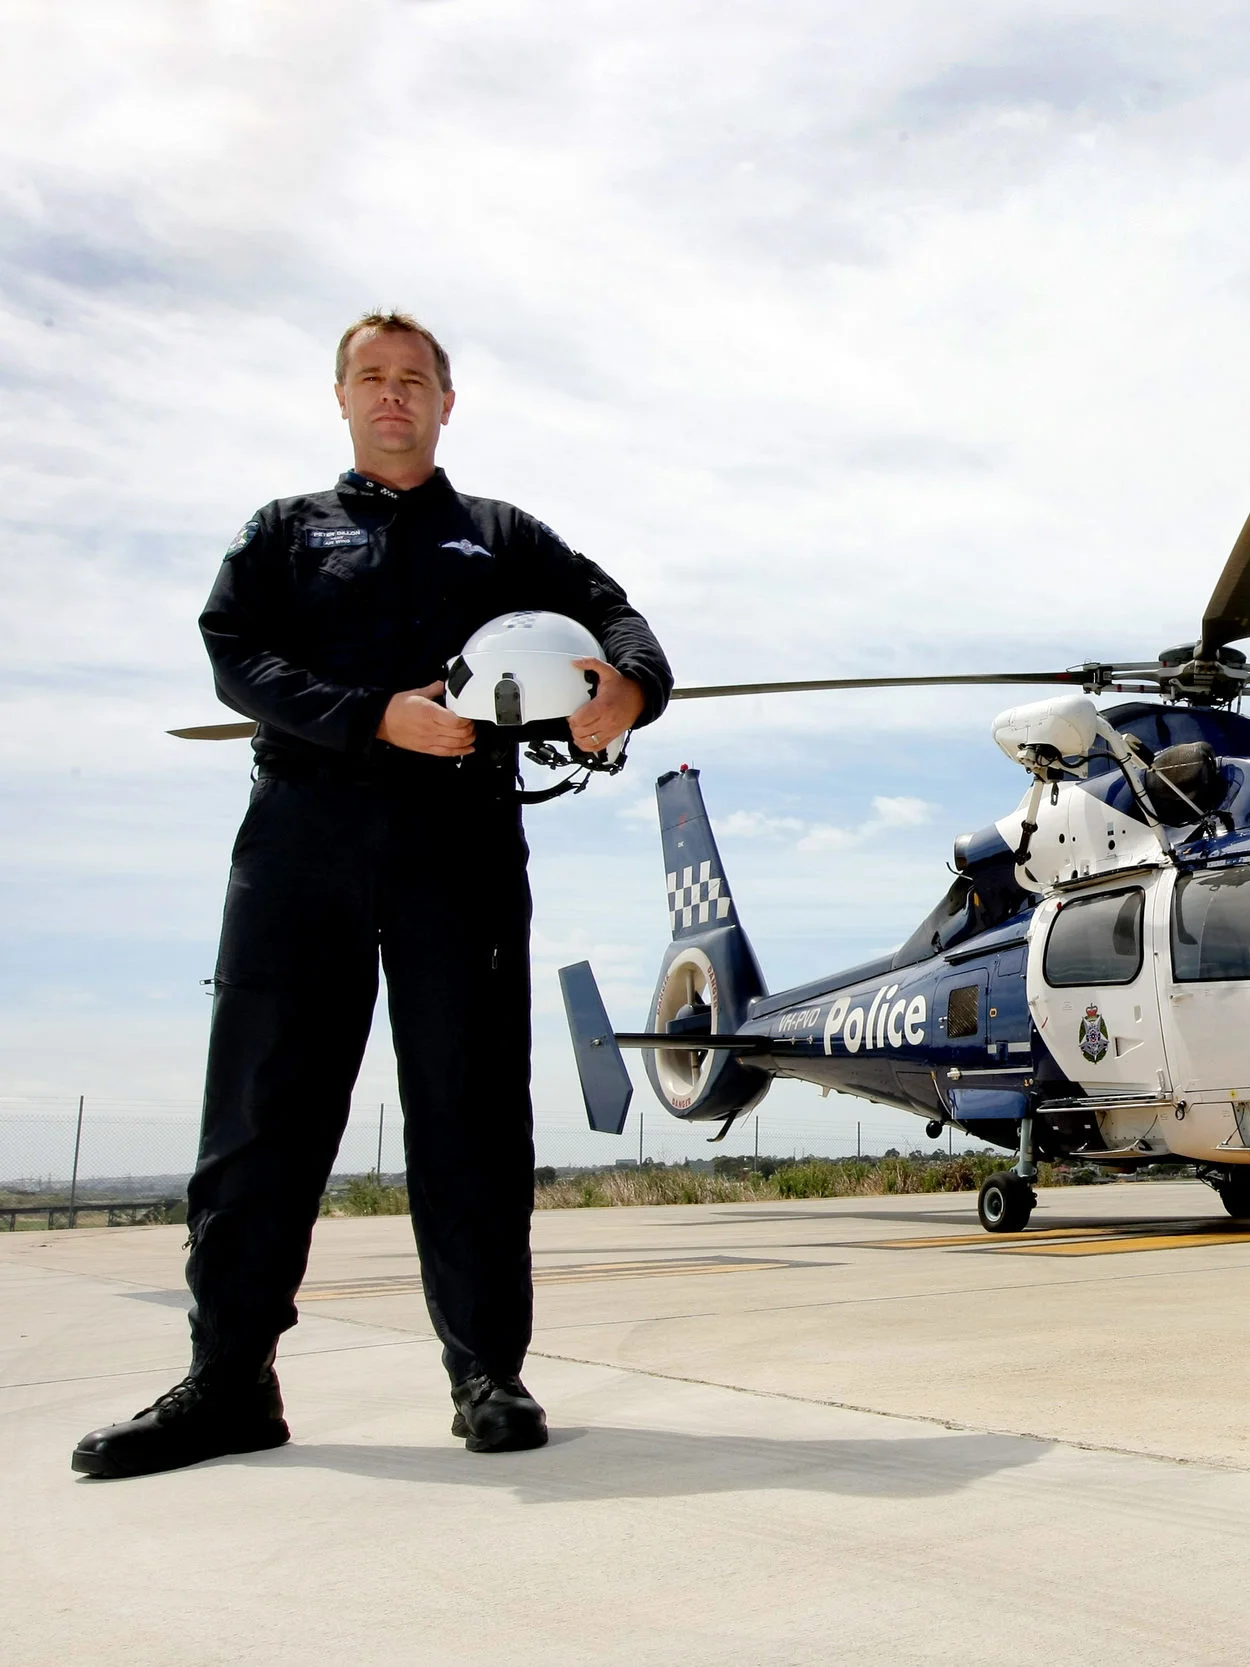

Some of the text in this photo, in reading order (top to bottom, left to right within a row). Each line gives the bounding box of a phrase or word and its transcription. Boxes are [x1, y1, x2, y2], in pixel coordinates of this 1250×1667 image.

[707, 964, 719, 1009] DANGER
[778, 983, 927, 1056] VH-PVD Police
[671, 1097, 691, 1108] DANGER
